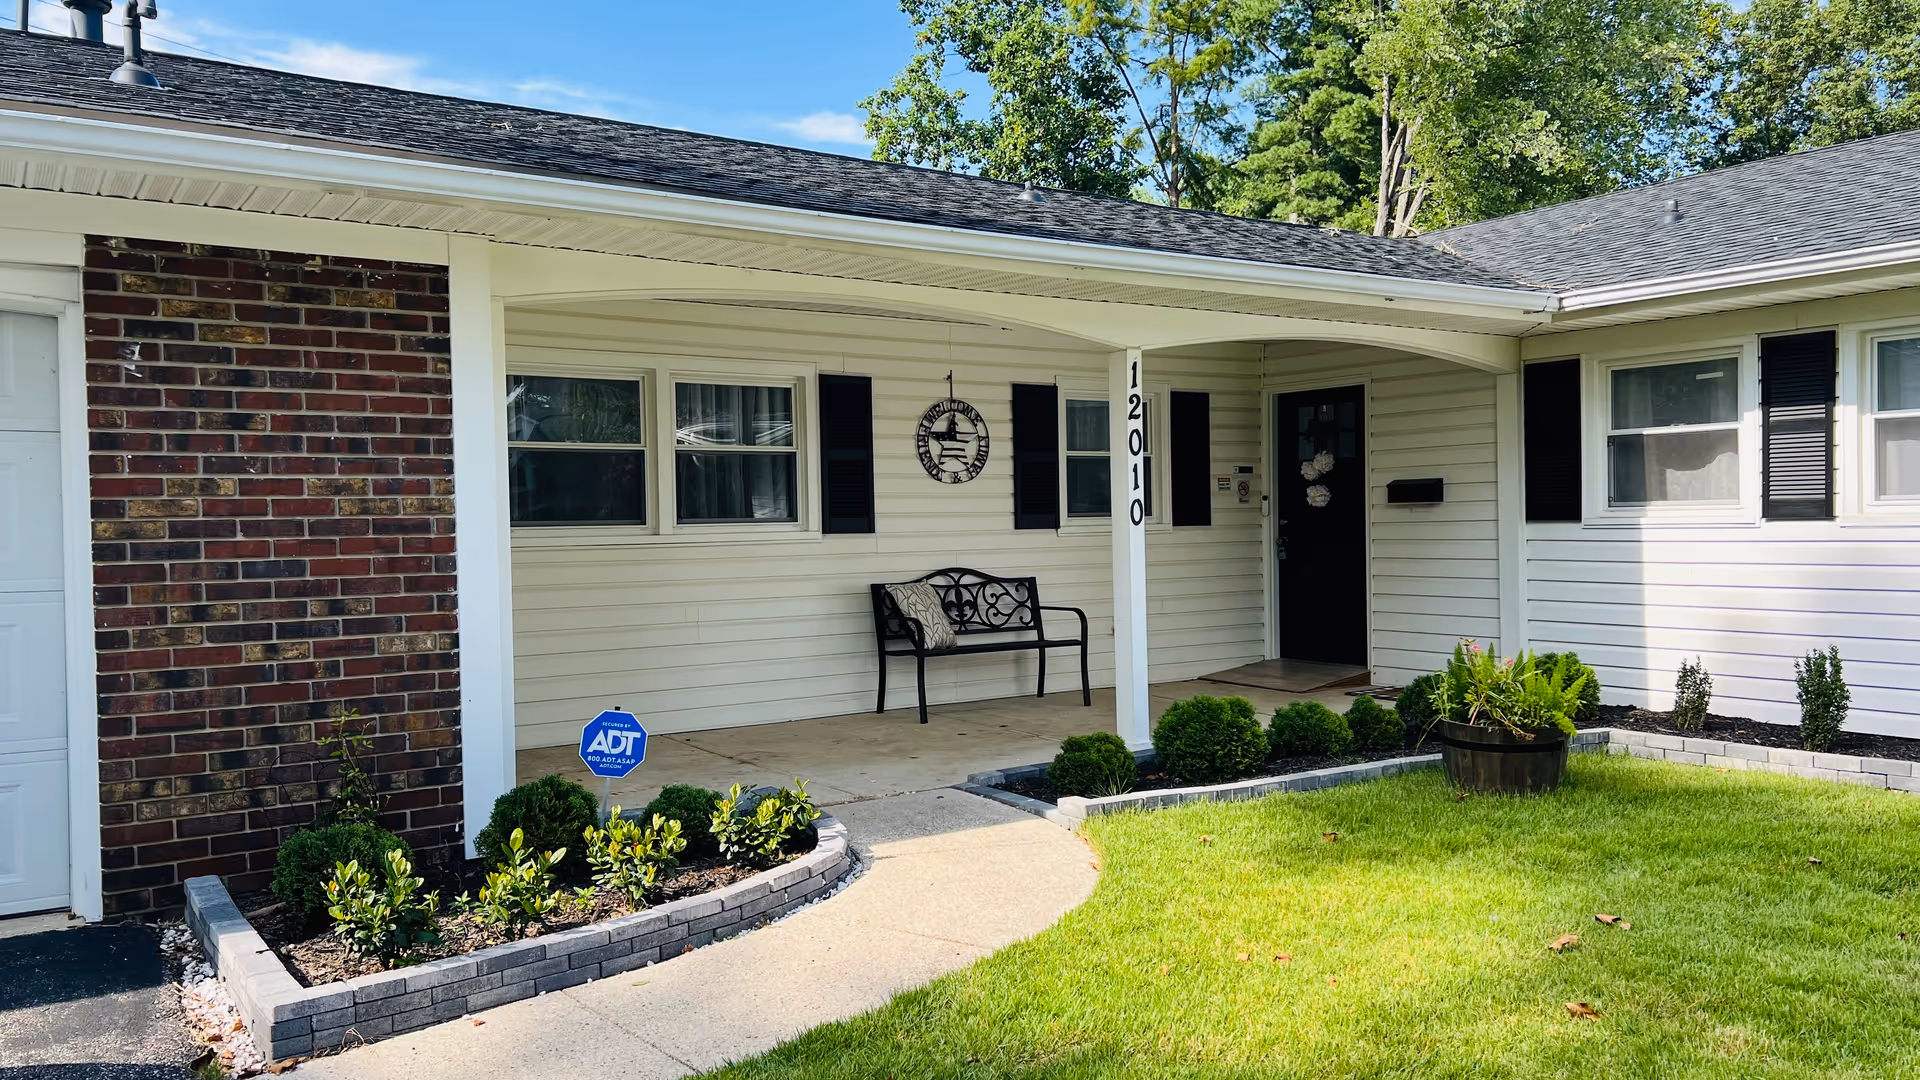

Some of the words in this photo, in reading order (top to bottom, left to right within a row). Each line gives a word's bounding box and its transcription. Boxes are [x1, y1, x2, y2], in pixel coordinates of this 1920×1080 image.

[924, 401, 982, 427] WELCOME
[1128, 361, 1143, 526] 12010
[954, 472, 962, 483] &
[969, 436, 989, 481] FAMILY
[587, 729, 641, 755] ADT
[587, 756, 635, 764] 800.ADT.ASAP
